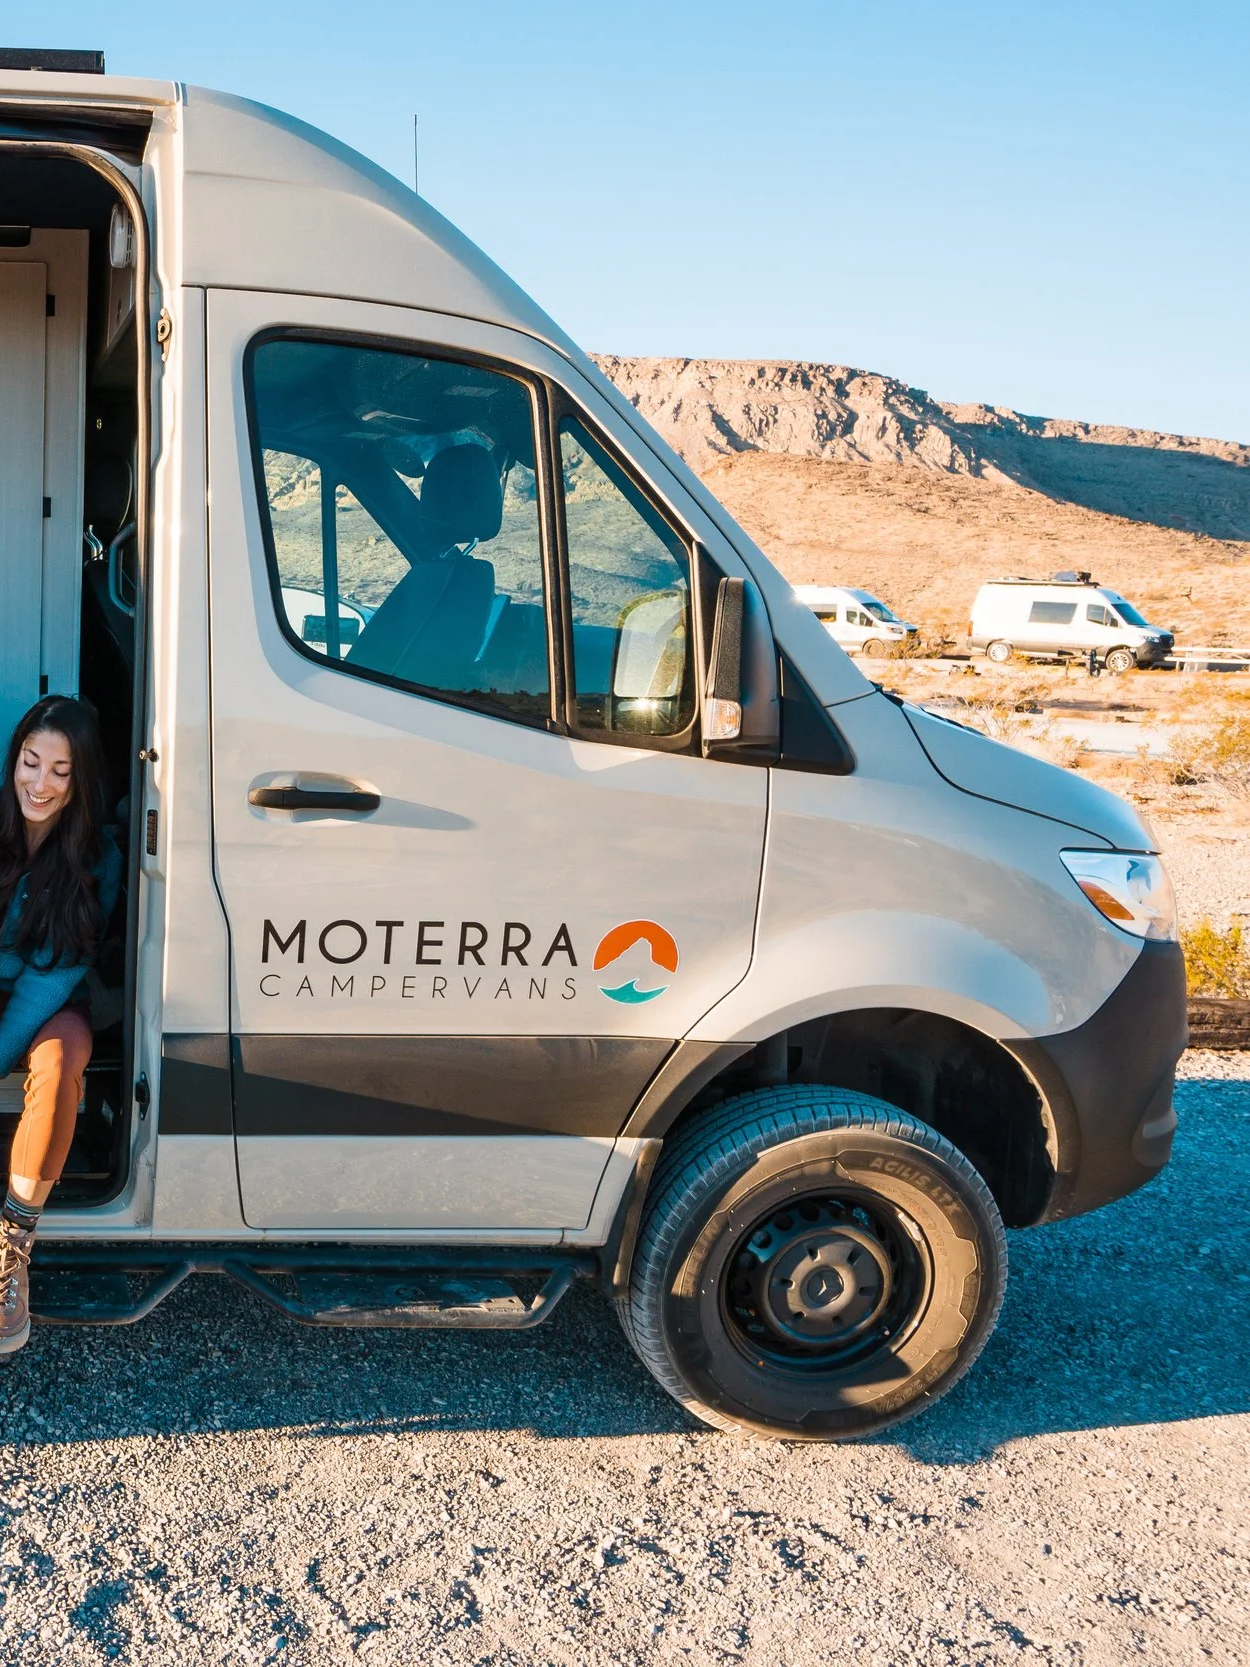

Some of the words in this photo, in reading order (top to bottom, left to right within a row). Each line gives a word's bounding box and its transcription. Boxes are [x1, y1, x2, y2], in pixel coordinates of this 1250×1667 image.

[260, 919, 578, 967] MOTERRA
[259, 974, 578, 1000] CAMPERVANS
[869, 1157, 931, 1187] AGILIS
[930, 1186, 961, 1215] LTX
